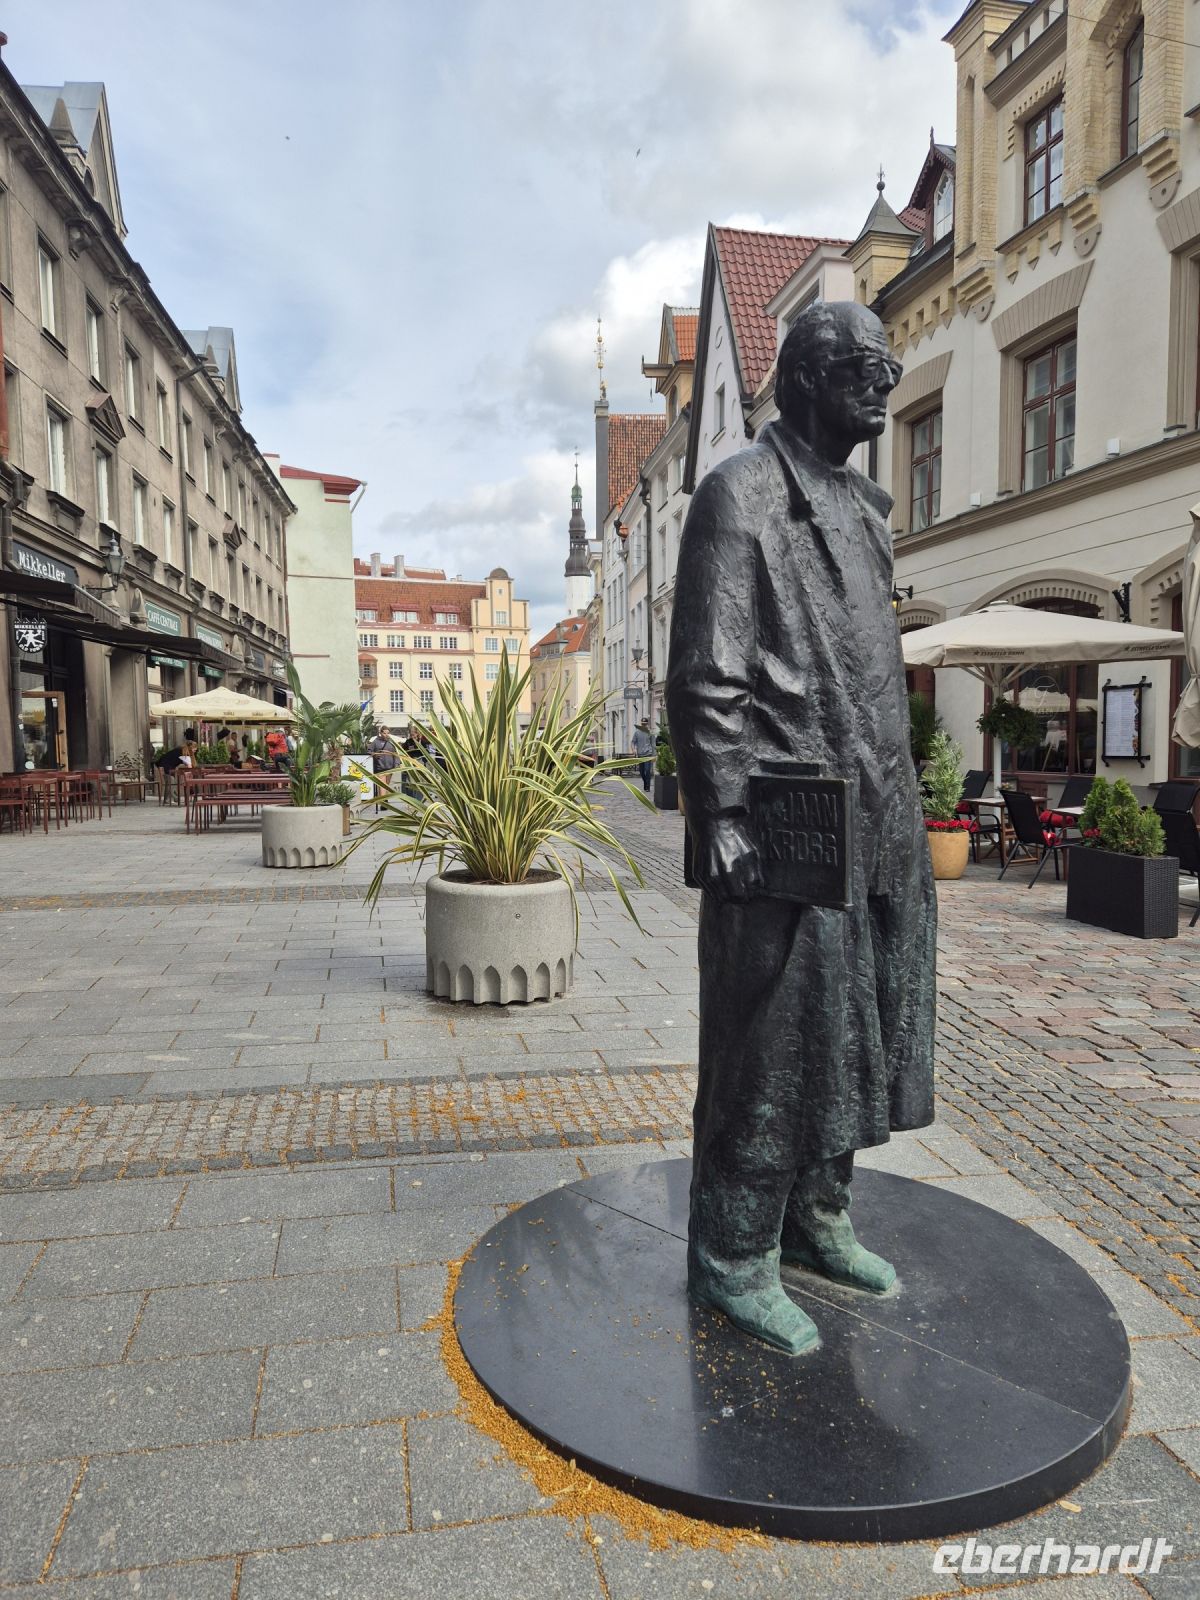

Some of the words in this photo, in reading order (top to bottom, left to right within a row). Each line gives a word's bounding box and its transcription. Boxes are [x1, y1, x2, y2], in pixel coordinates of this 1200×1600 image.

[18, 550, 66, 583] Mikkeller
[783, 791, 838, 827] JAAN
[766, 828, 838, 867] KROSS
